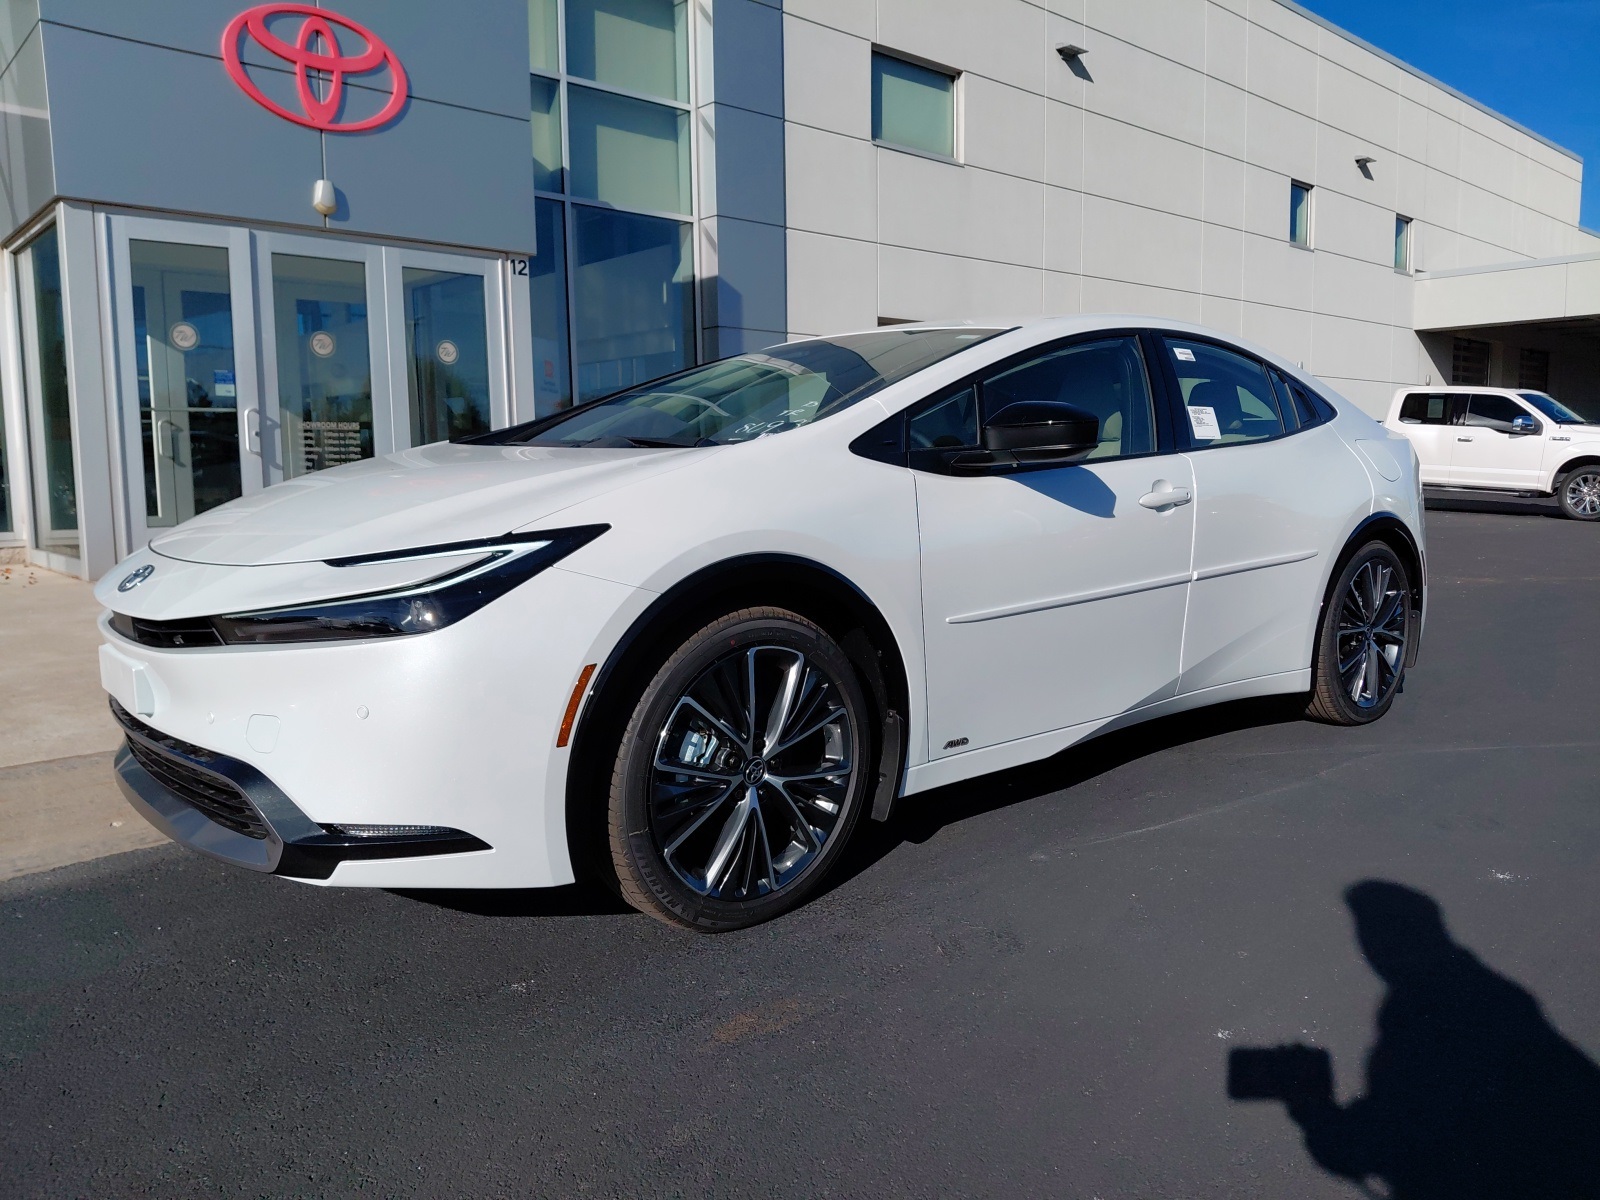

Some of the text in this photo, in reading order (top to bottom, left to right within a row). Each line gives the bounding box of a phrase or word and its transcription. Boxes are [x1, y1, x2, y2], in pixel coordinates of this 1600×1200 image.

[510, 259, 528, 276] 12
[298, 421, 360, 430] SHOWROOM HOURS
[942, 737, 970, 750] AWD
